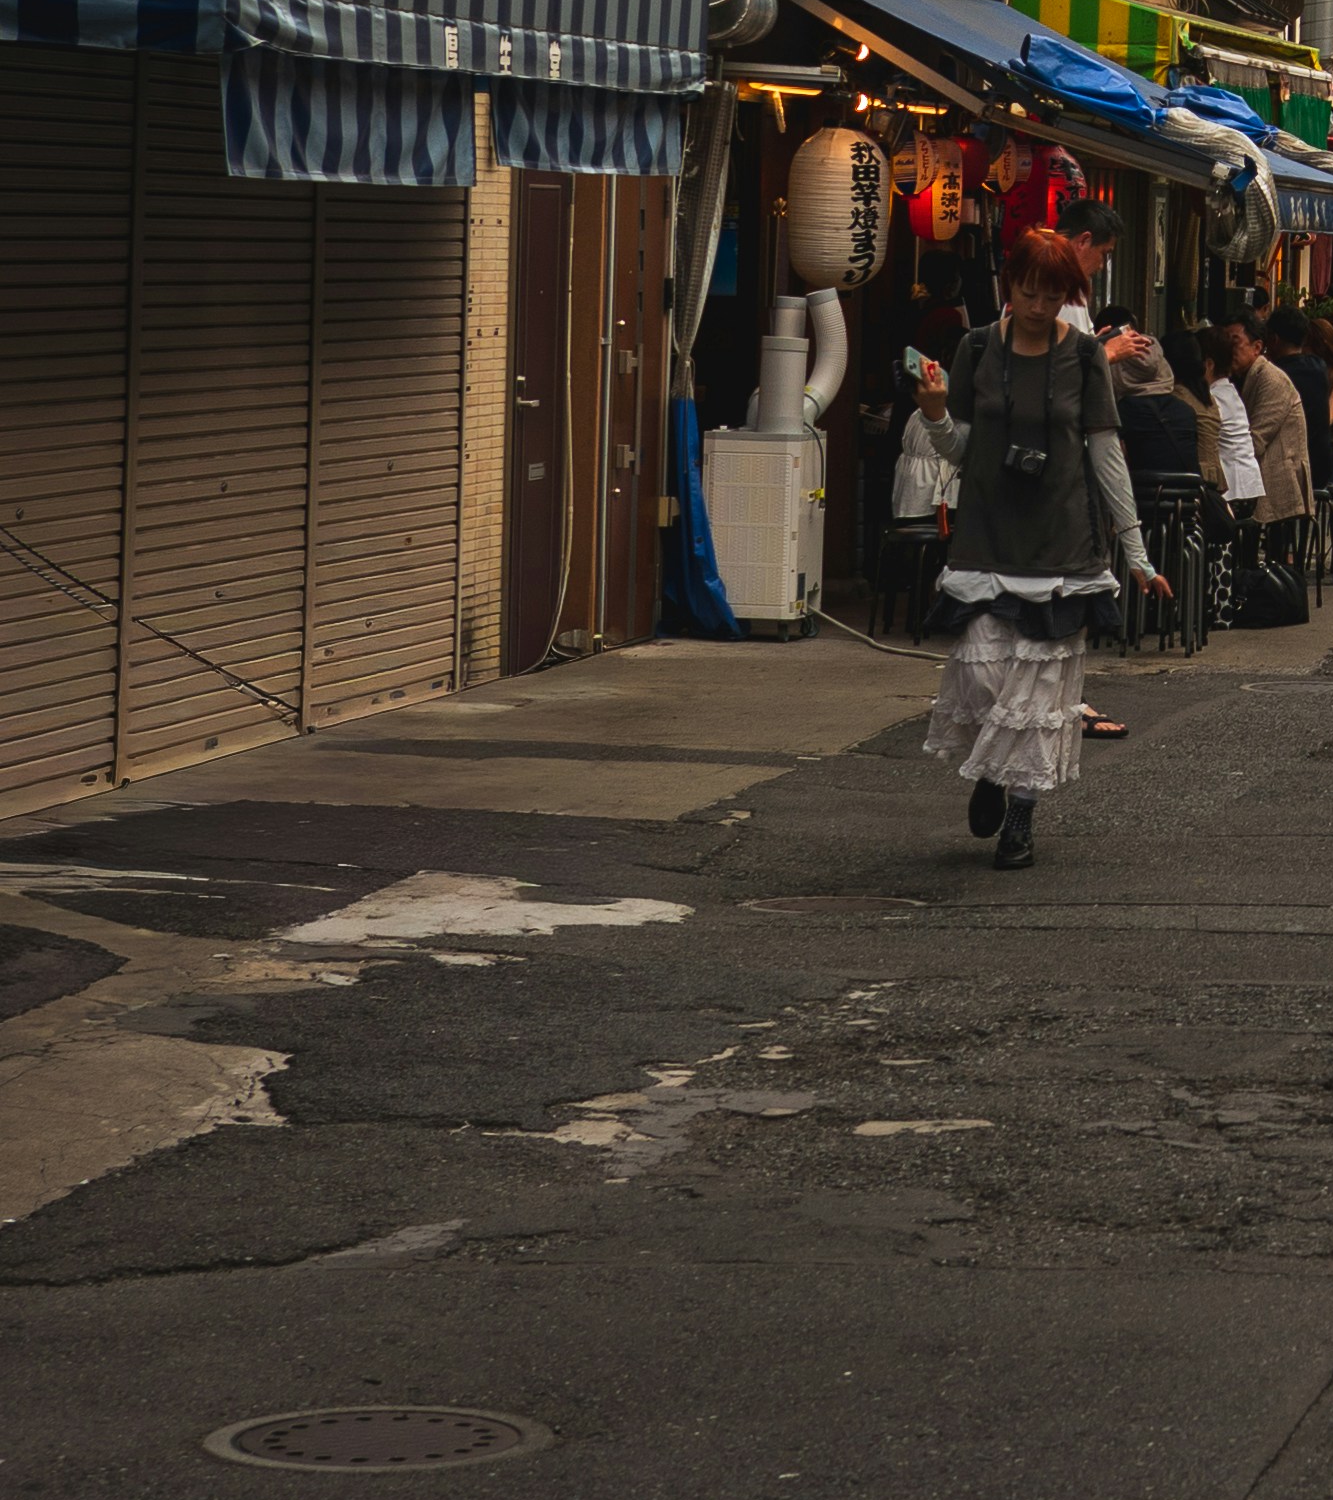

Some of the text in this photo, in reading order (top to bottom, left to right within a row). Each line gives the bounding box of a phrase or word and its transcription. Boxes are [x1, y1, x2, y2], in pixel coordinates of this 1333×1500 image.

[843, 141, 882, 285] 秋田竿燈まつり
